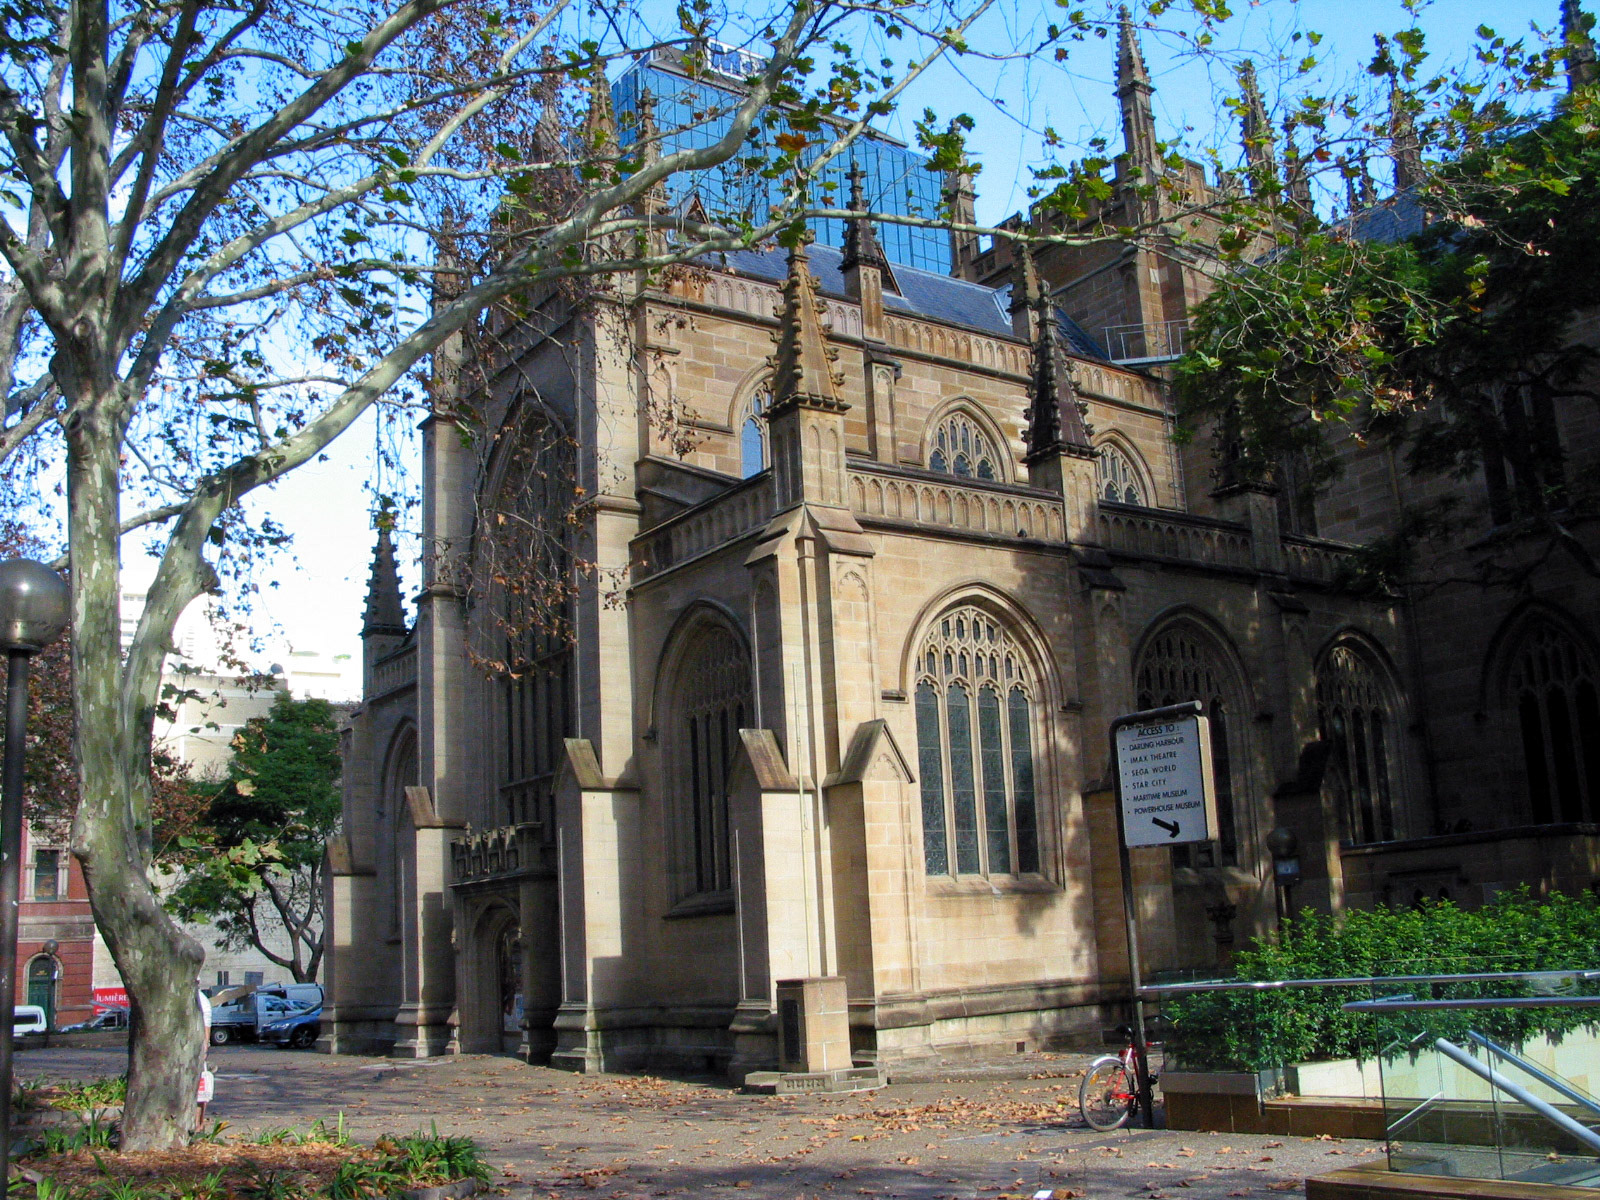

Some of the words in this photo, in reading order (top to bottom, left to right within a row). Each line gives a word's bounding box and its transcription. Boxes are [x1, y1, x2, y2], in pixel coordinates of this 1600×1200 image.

[1138, 726, 1163, 737] ACCESS
[1129, 741, 1155, 751] DARLING
[1155, 736, 1185, 747] HARBOUR
[1130, 756, 1149, 764] IMAX
[1150, 750, 1177, 761] THEATRE
[1131, 768, 1149, 777] SEGA
[1152, 764, 1177, 774] WORLD
[1132, 781, 1149, 790] STAR
[1151, 778, 1167, 787] CITY
[1133, 792, 1161, 802] MARITIME
[1162, 789, 1188, 799] MUSEUM
[1134, 803, 1174, 815] POWERHOUSE
[1175, 800, 1201, 811] MUSEUM
